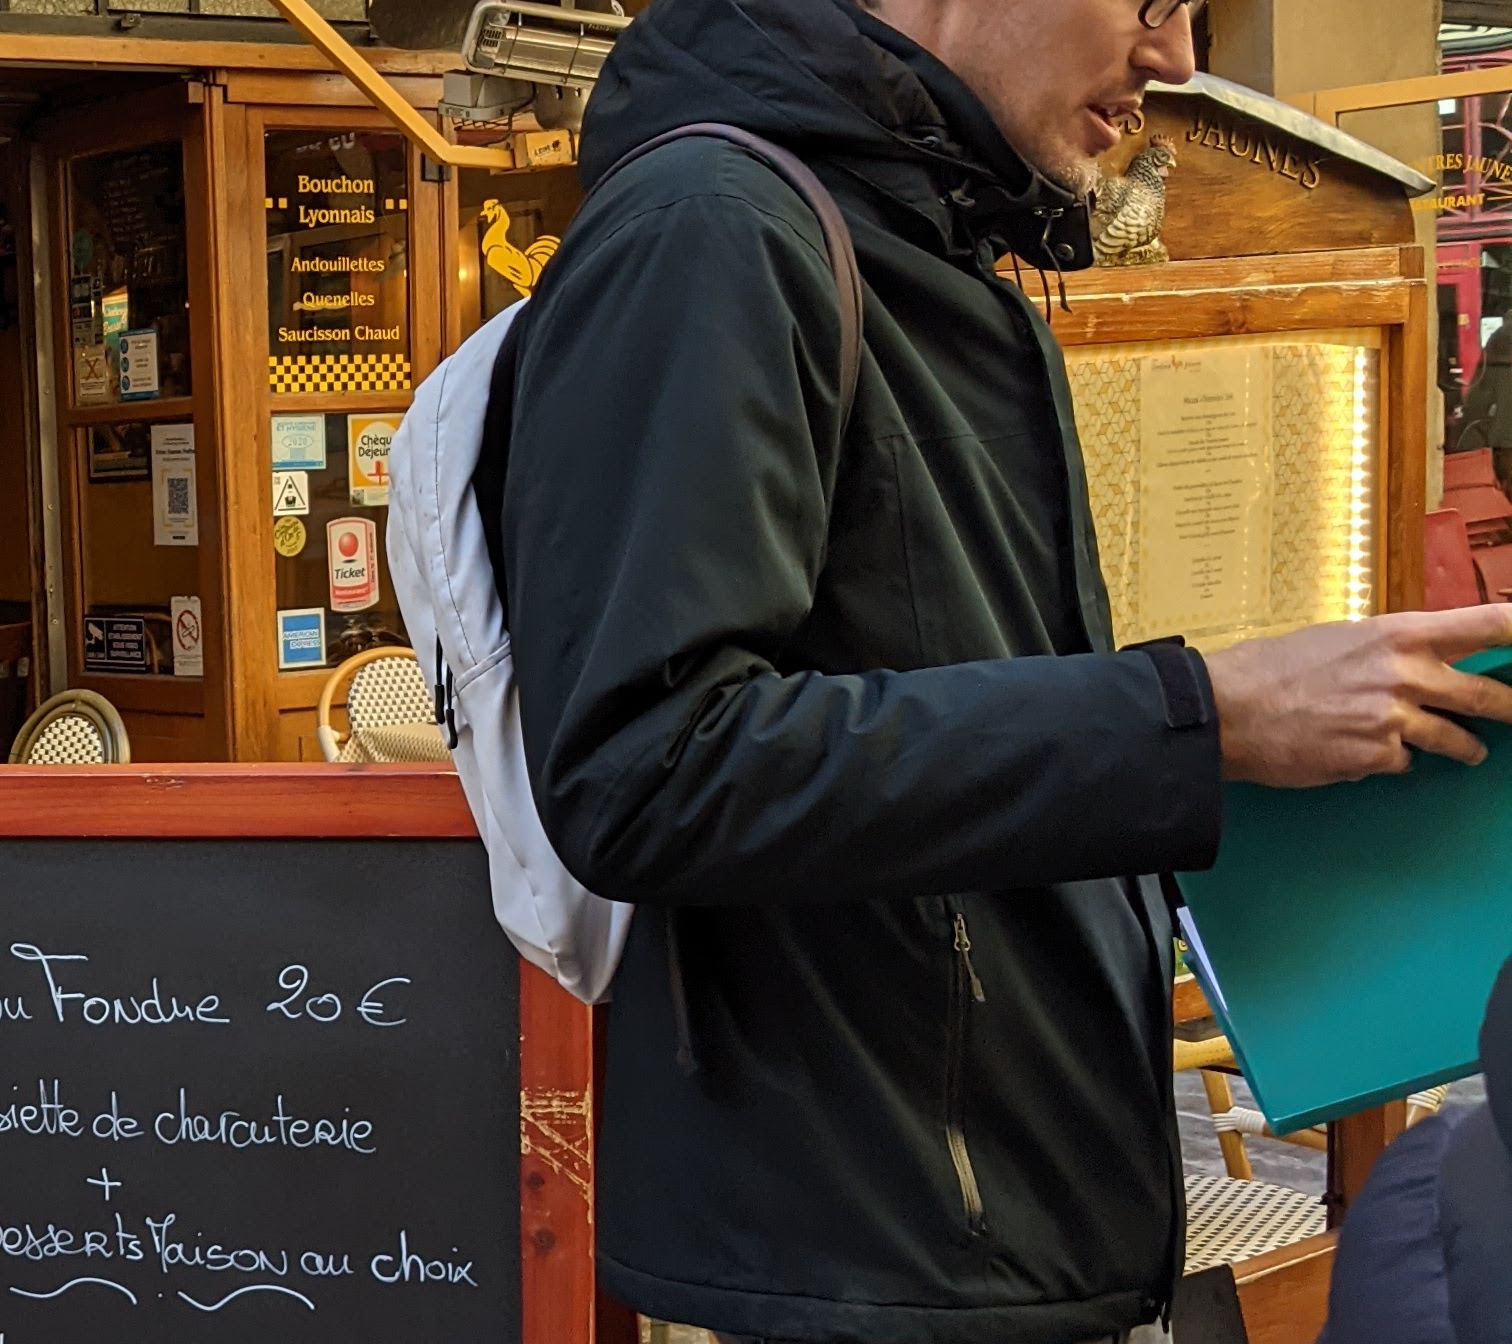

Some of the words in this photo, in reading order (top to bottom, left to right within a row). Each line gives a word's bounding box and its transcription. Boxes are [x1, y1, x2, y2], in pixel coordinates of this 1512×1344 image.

[1186, 111, 1320, 189] JAUNES
[298, 175, 374, 193] Bouchon
[299, 205, 375, 228] Lyonnais
[291, 256, 385, 272] Andouillettes
[303, 292, 375, 308] Quenelles
[278, 326, 350, 342] Saucisson
[354, 325, 400, 341] Chaud
[360, 434, 393, 447] Chèqu
[334, 567, 366, 580] Ticket
[9, 943, 231, 1025] Fondue
[93, 1090, 145, 1138] de
[154, 1087, 377, 1154] charcuterie
[145, 1212, 290, 1275] Maison
[300, 1250, 354, 1276] au
[371, 1231, 478, 1287] choix
